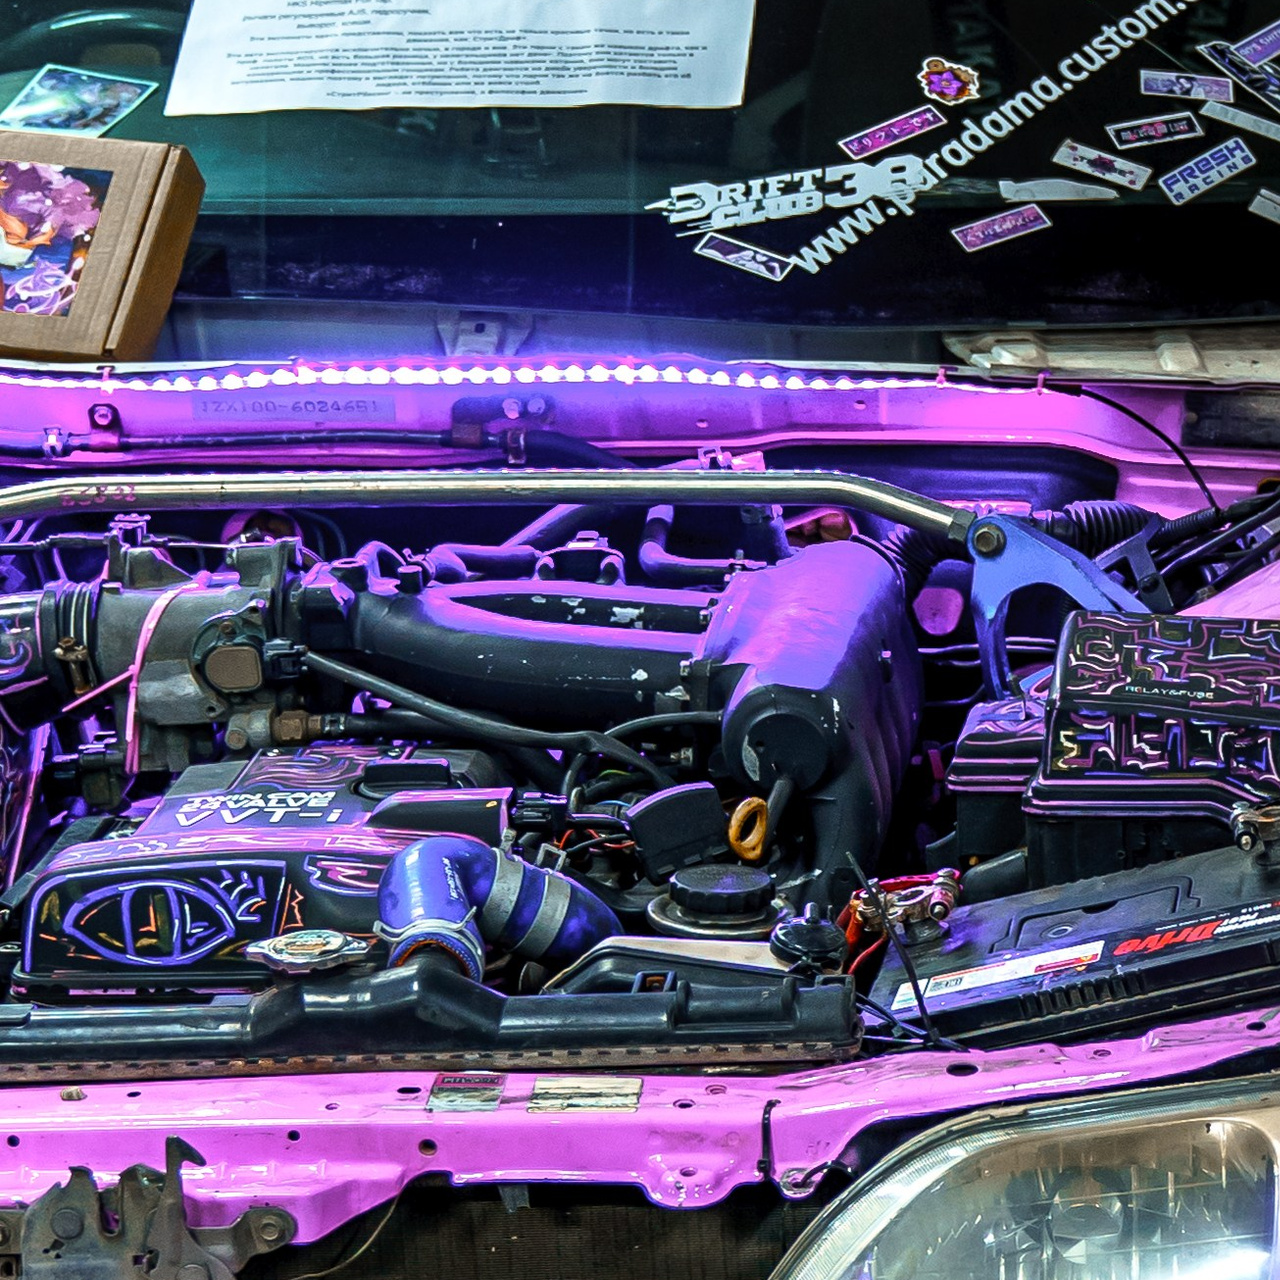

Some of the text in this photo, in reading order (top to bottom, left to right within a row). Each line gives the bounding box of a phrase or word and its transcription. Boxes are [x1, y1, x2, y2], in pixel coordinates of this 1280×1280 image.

[669, 154, 925, 224] DRIFT 38
[1173, 156, 1252, 203] RACING
[1125, 684, 1215, 700] RELAY&FUSE
[175, 808, 344, 827] VVT-i
[1113, 919, 1226, 957] Drive
